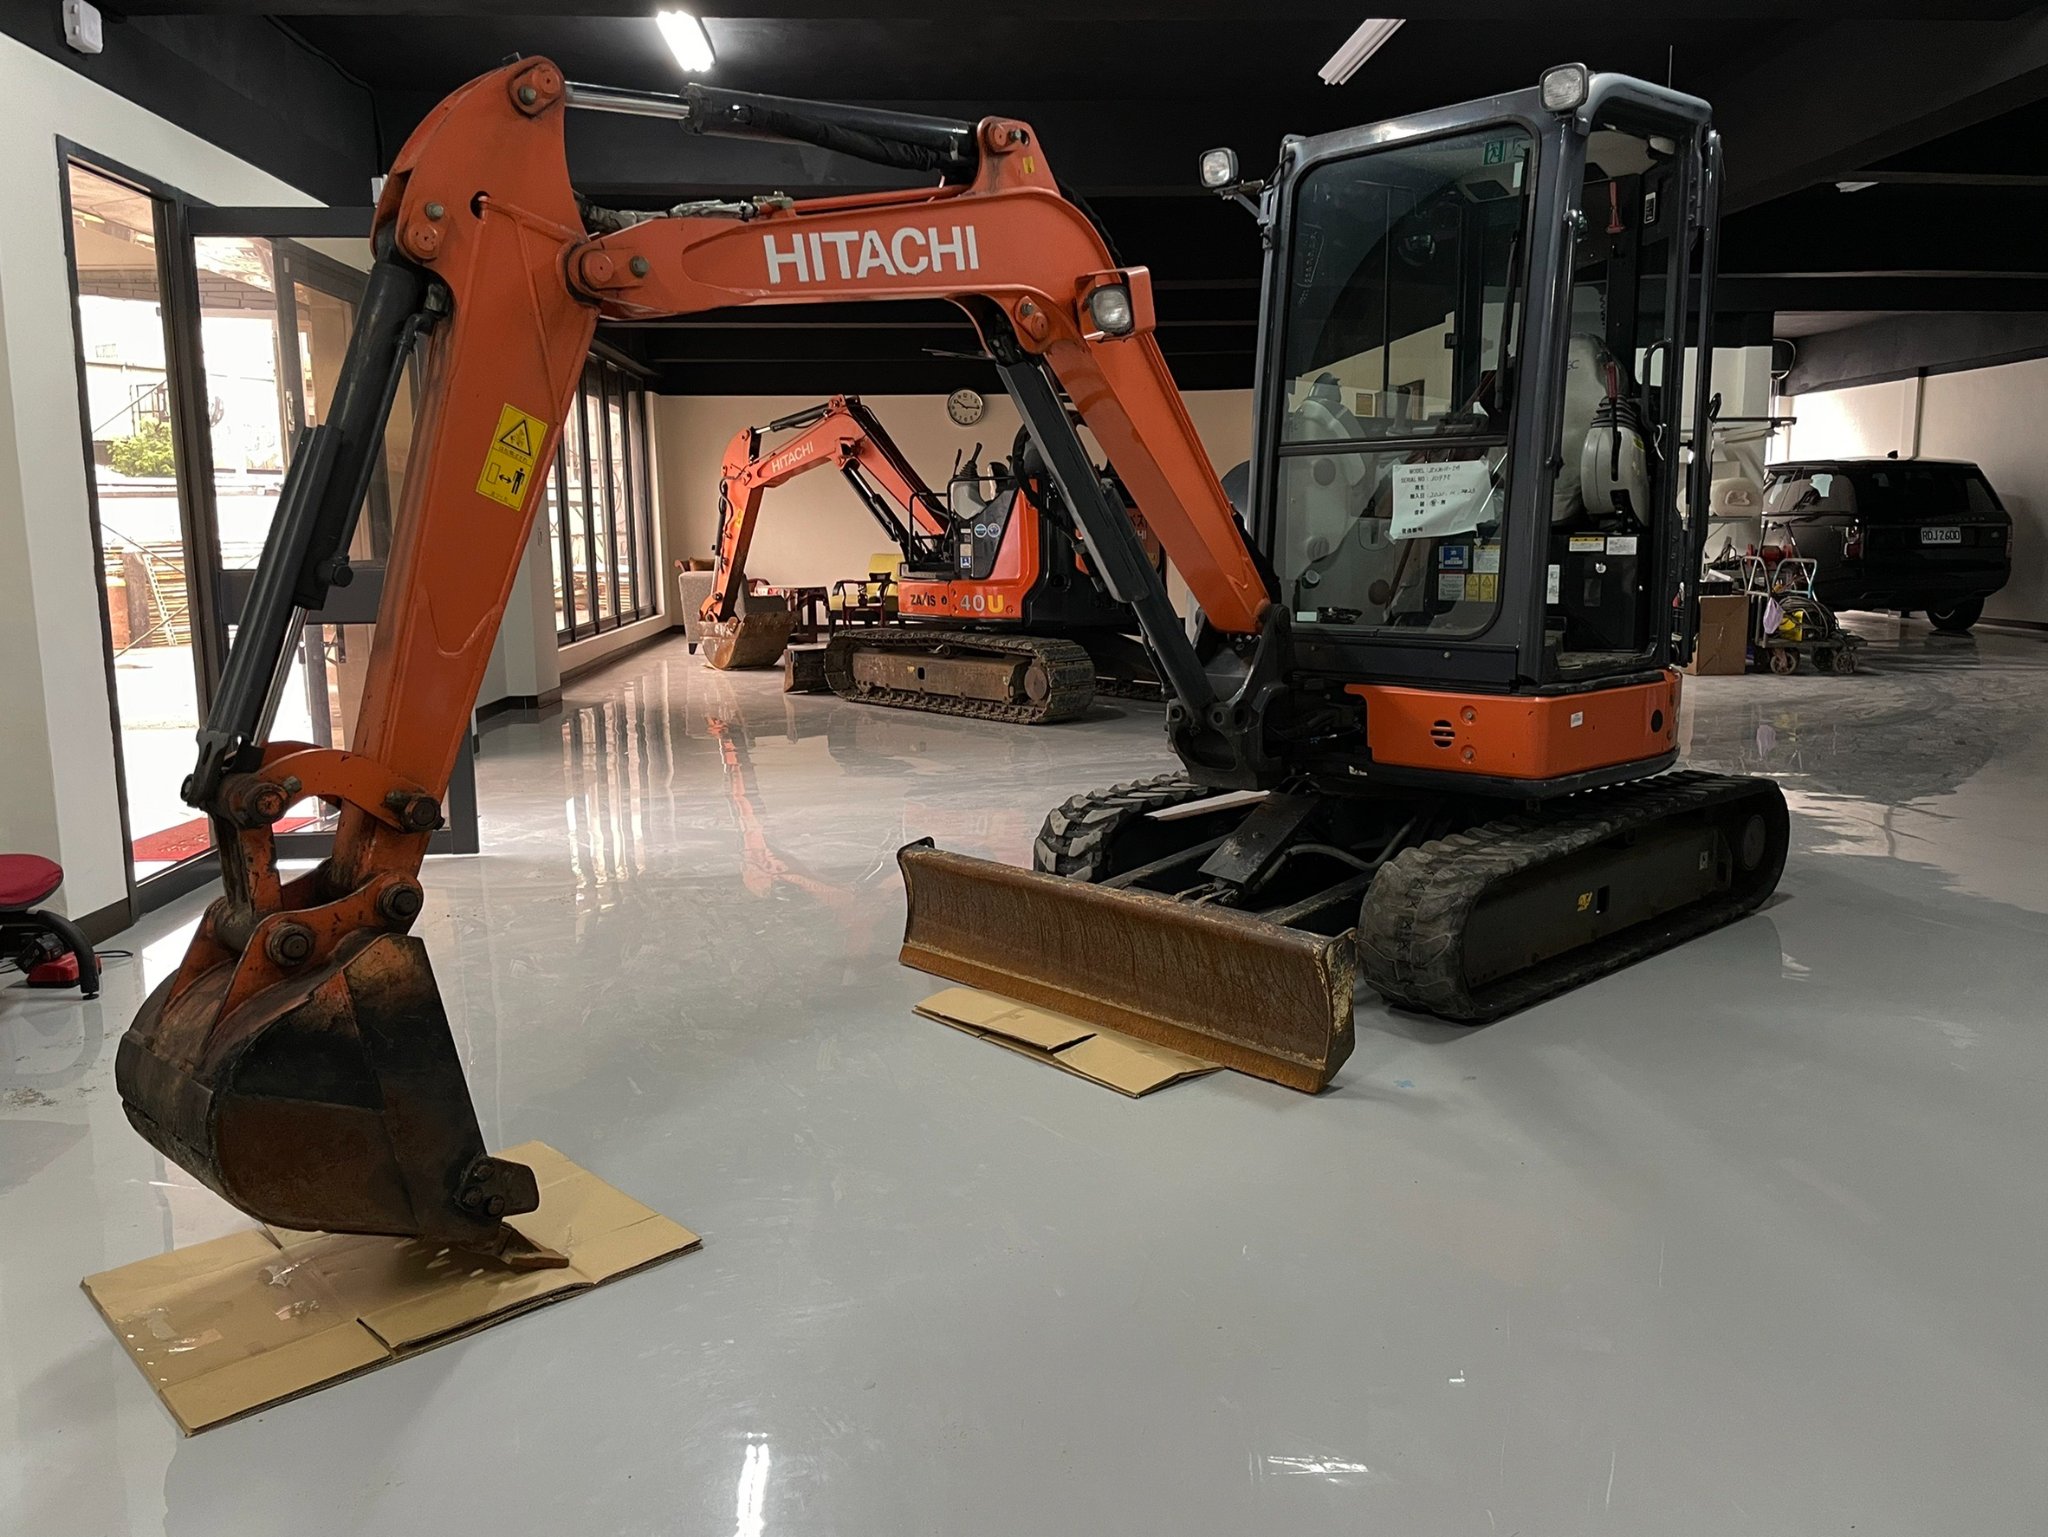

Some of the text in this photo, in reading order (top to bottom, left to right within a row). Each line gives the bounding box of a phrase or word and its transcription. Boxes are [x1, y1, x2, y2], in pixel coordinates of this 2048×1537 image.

[763, 225, 979, 284] HITACHI
[771, 440, 814, 474] HITACHI
[960, 594, 1004, 614] 40U
